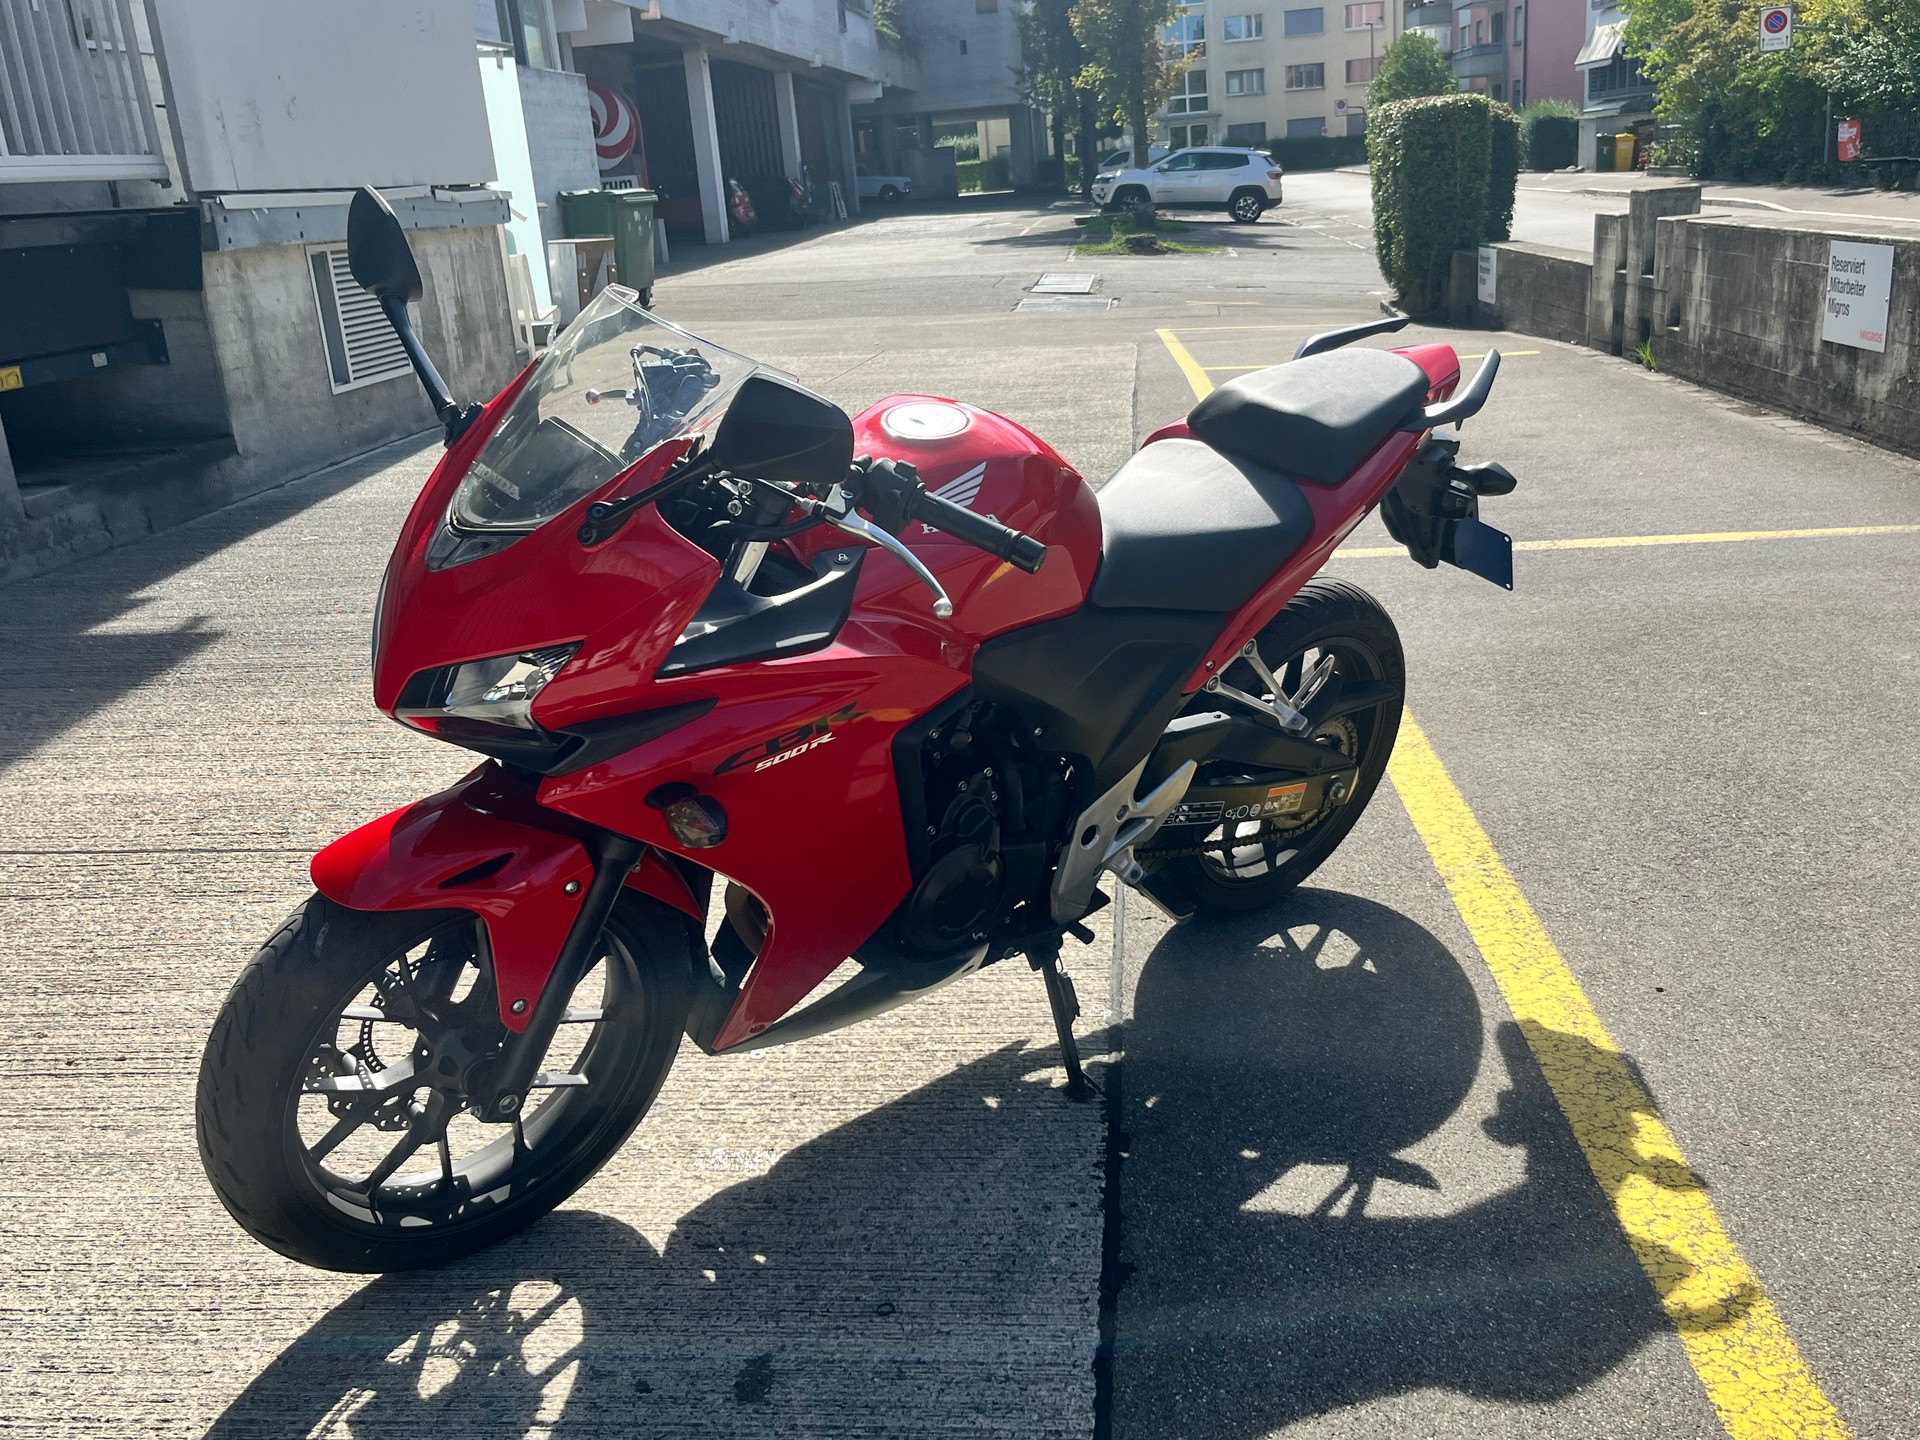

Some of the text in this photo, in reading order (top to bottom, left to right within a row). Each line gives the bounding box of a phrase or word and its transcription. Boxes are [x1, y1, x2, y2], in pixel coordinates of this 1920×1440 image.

[1831, 255, 1866, 275] Reserviert
[1829, 276, 1867, 297] Mitarbeiter
[1827, 297, 1850, 318] Migros
[1860, 329, 1883, 343] MIGROS
[474, 462, 521, 500] HONDA
